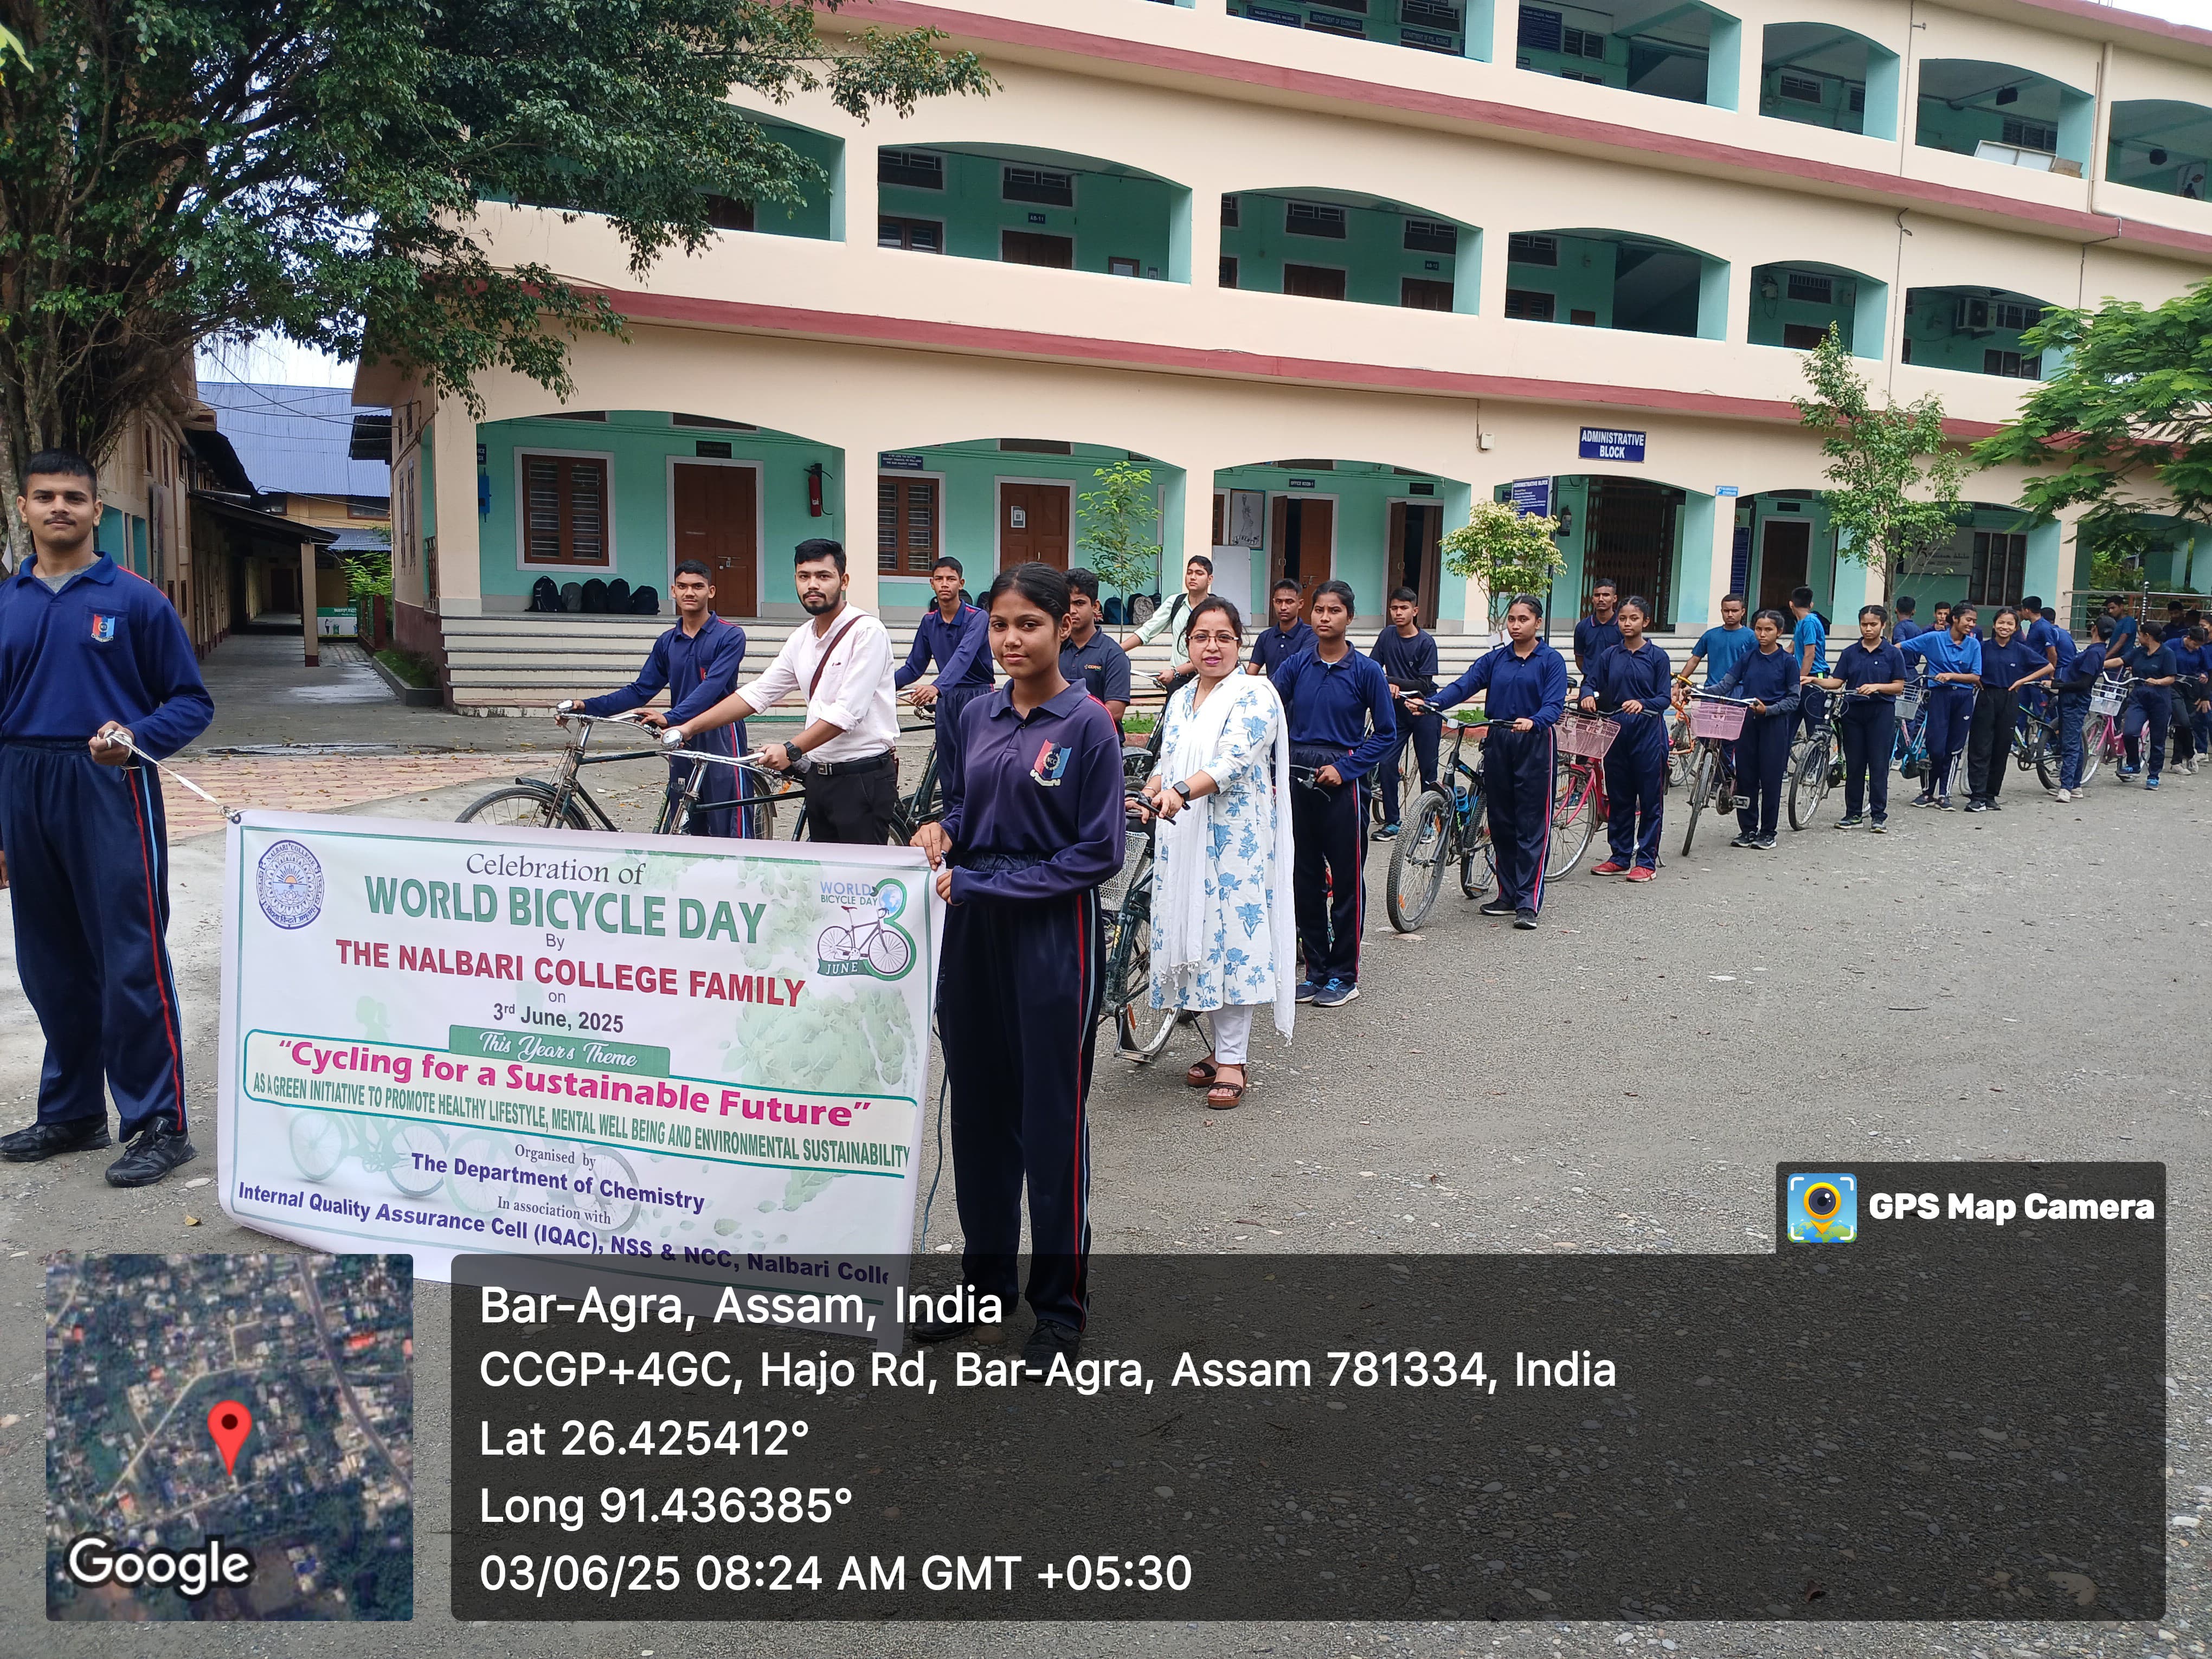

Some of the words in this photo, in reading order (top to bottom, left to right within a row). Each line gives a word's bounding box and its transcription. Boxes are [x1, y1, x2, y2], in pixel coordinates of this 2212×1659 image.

[1581, 430, 1645, 447] ADMINISTRATIVE
[1599, 445, 1625, 459] BLOCK
[266, 844, 288, 863] NALBARI
[467, 854, 609, 882] Celebration
[619, 863, 646, 885] of
[820, 881, 871, 896] WORLD
[821, 895, 856, 905] BICYCLE
[860, 897, 878, 906] DAY
[364, 876, 497, 922] WORLD
[509, 886, 665, 936] BICYCLE
[679, 898, 767, 943] DAY
[546, 934, 564, 951] By
[336, 939, 389, 968] THE
[400, 945, 523, 981] NALBARI
[535, 957, 677, 995] COLLEGE
[690, 970, 806, 1007] FAMILY
[826, 962, 858, 975] JUNE
[549, 992, 565, 1003] on
[494, 1003, 515, 1020] 3rd
[521, 1006, 571, 1031] June,
[579, 1012, 623, 1033] 2025
[479, 1031, 511, 1053] This
[583, 1042, 638, 1067] Theme
[422, 1054, 468, 1082] for
[478, 1067, 495, 1086] a
[506, 1064, 709, 1113] Sustainable
[254, 1072, 265, 1093] AS
[267, 1075, 273, 1095] A
[274, 1076, 306, 1099] GREEN
[310, 1080, 365, 1105] INITIATIVE
[369, 1086, 382, 1107] TO
[385, 1088, 435, 1113] PROMOTE
[439, 1094, 486, 1120] HEALTHY
[490, 1101, 548, 1133] LIFESTYLE,
[552, 1108, 595, 1134] MENTAL
[600, 1114, 628, 1139] WELL
[632, 1118, 665, 1144] BEING
[668, 1124, 691, 1148] AND
[695, 1128, 799, 1160] ENVIRONMENTAL
[803, 1139, 910, 1167] SUSTAINABILITY
[515, 1144, 575, 1164] Organised
[583, 1153, 596, 1171] by
[411, 1153, 447, 1173] The
[454, 1158, 568, 1191] Department
[574, 1177, 593, 1194] of
[600, 1179, 705, 1215] Chemistry
[498, 1196, 509, 1209] In
[514, 1203, 580, 1219] association
[584, 1210, 610, 1224] with
[239, 1182, 304, 1207] Internal
[310, 1193, 370, 1222] Quality
[375, 1204, 485, 1232] Assurance
[492, 1218, 527, 1239] Cell
[534, 1224, 603, 1255] (IQAC),
[610, 1235, 652, 1258] NSS
[660, 1242, 676, 1261] &
[685, 1246, 739, 1272] NCC,
[748, 1253, 829, 1278] Nalbari
